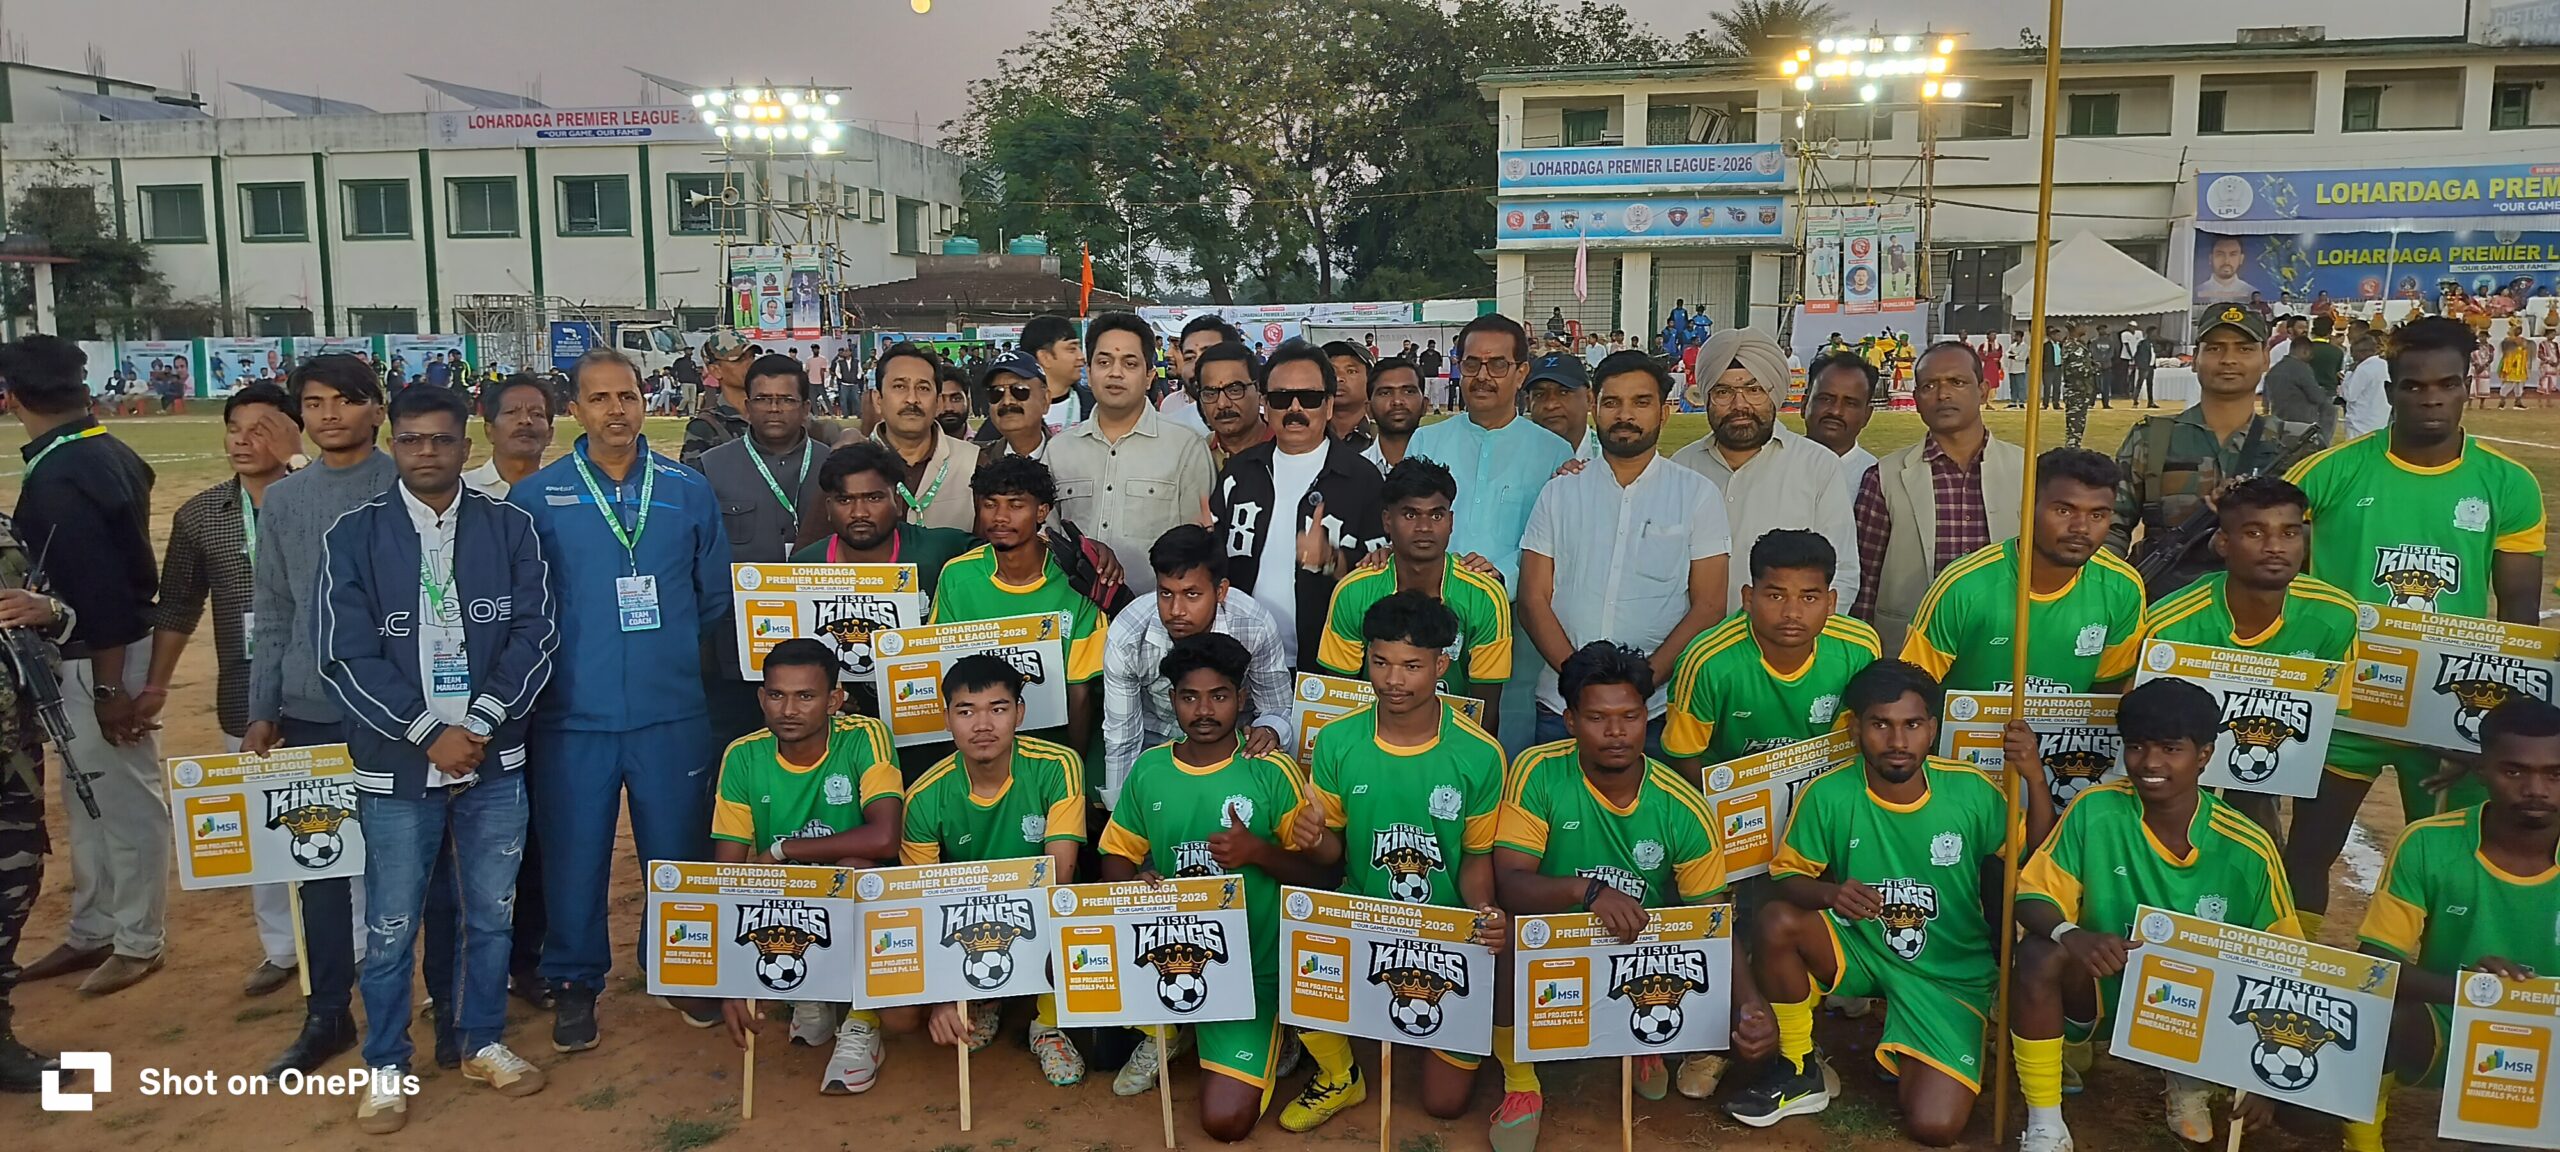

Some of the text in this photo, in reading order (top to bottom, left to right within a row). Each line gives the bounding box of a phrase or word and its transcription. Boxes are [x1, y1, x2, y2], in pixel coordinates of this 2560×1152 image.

[468, 112, 552, 129] LOHARDAGA
[557, 111, 618, 127] PREMIER
[1530, 160, 1604, 175] LOHARDAGA
[1608, 159, 1662, 174] PREMIER
[2316, 179, 2479, 204] LOHARDAGA
[2493, 202, 2525, 212] "OUR
[2317, 248, 2441, 266] LOHARDAGA
[2449, 245, 2540, 262] PREMIER
[2402, 545, 2437, 555] KISKO
[792, 567, 856, 576] LOHARDAGA
[2378, 551, 2456, 584] KINGS
[766, 577, 884, 585] PREMIER LEAGUE-2026
[837, 595, 873, 603] KISKO
[818, 601, 898, 629] KINGS
[935, 623, 1000, 636] LOHARDAGA
[2421, 614, 2506, 635] LOHARDAGA
[909, 628, 1027, 648] PREMIER LEAGUE-2026
[2384, 618, 2542, 650] PREMIER LEAGUE-2026
[2211, 650, 2280, 668] LOHARDAGA
[2473, 653, 2521, 667] KISKO
[2179, 658, 2308, 681] PREMIER LEAGUE-2026
[2379, 674, 2403, 685] MSR
[2440, 657, 2547, 701] KINGS
[436, 683, 468, 691] MANAGER
[915, 687, 934, 695] MSR
[2250, 689, 2290, 699] KISKO
[1329, 689, 1376, 702] PREMIER
[2024, 699, 2092, 708] OHARDAGA
[1984, 707, 2118, 717] PREER LEAGUE-202
[2222, 694, 2308, 734] KINGS
[1766, 738, 1831, 763] LOHARDAGA
[208, 765, 263, 778] PREMIER
[265, 757, 344, 773] LEAGUE-2026
[1980, 758, 2002, 766] MSR
[1738, 761, 1786, 779] PREMIER
[291, 779, 333, 789] KISKO
[269, 783, 358, 823] KINGS
[217, 823, 238, 833] MSR
[1744, 817, 1763, 828] MSR
[1184, 842, 1209, 850] KISK
[1374, 831, 1441, 863] KINGS
[716, 867, 787, 878] LOHARDAGA
[919, 865, 989, 879] LOHARDAGA
[1598, 866, 1629, 878] KISKO
[686, 876, 817, 889] PREMIER LEAGUE-2026
[889, 873, 1019, 891] PREMIER LEAGUE-2026
[764, 900, 802, 908] KISKO
[968, 894, 1006, 904] KISKO
[1082, 893, 1208, 907] PREMIER LEAGUE-2026
[1349, 900, 1423, 918] LOHARDAGA
[739, 907, 827, 939] KINGS
[944, 900, 1032, 939] KINGS
[1158, 916, 1196, 925] KISKO
[1318, 906, 1455, 933] PREMIER LEAGUE-2026
[688, 932, 709, 941] MSR
[1556, 927, 1610, 939] PREMIER
[893, 940, 914, 948] MSR
[1137, 923, 1224, 959] KINGS
[1398, 939, 1439, 952] KISKO
[2218, 927, 2309, 956] LOHARDAGA
[1638, 946, 1679, 956] KISKO
[2179, 930, 2347, 977] PREMIER LEAGUE-2026
[1089, 957, 1109, 966] MSR
[1373, 944, 1464, 988] KINGS
[2222, 953, 2299, 974] "OUR GAME, OUR FAME"
[1319, 965, 1341, 976] MSR
[1613, 952, 1705, 991] KINGS
[2274, 977, 2323, 995] KISKO
[1558, 991, 1580, 1000] MSR
[2170, 995, 2197, 1009] MSR
[2236, 979, 2352, 1041] KINGS
[2504, 1060, 2533, 1074] MSR
[2488, 1082, 2527, 1094] PROJECTS
[2466, 1088, 2536, 1103] MINERALS Pvt. Ltd.
